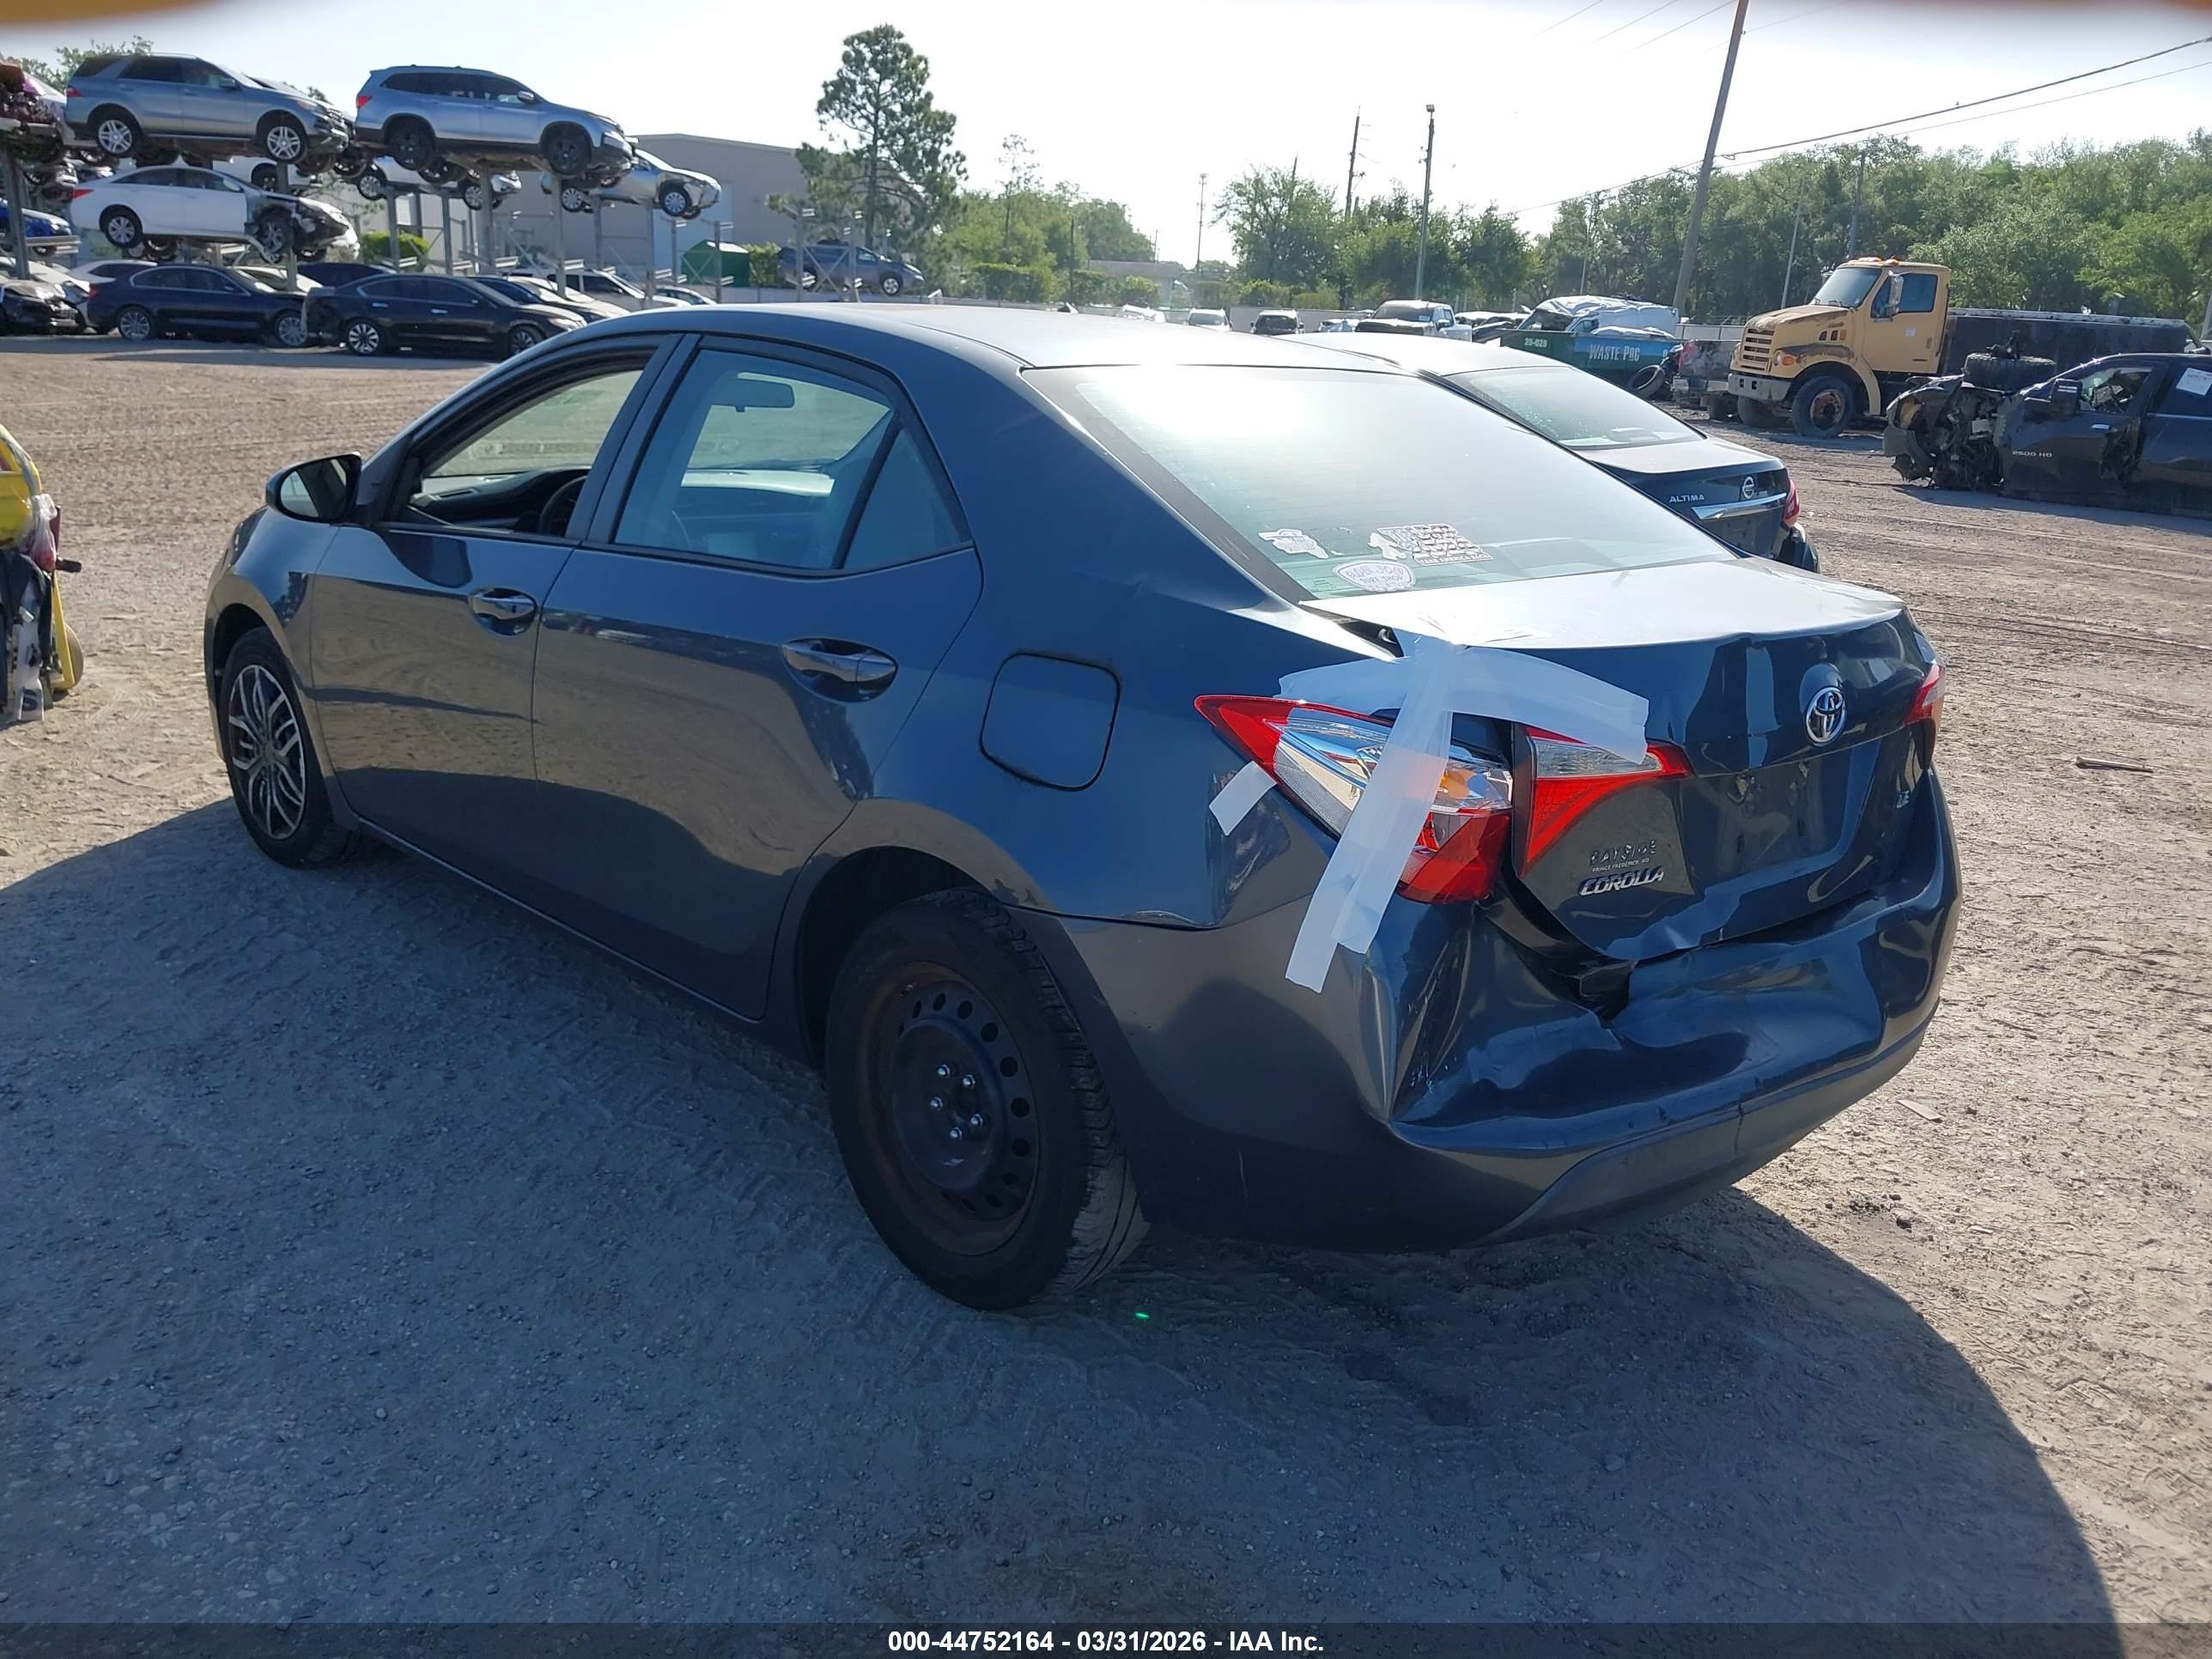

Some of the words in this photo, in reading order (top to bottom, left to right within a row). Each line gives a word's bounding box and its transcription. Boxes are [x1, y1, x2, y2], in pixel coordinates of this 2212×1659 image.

[1589, 344, 1620, 361] WASTE
[1668, 494, 1705, 503] ALTIMA
[1592, 865, 1611, 873] PRINCE
[1612, 860, 1639, 869] FREDERICK
[1579, 866, 1664, 896] COROLLA
